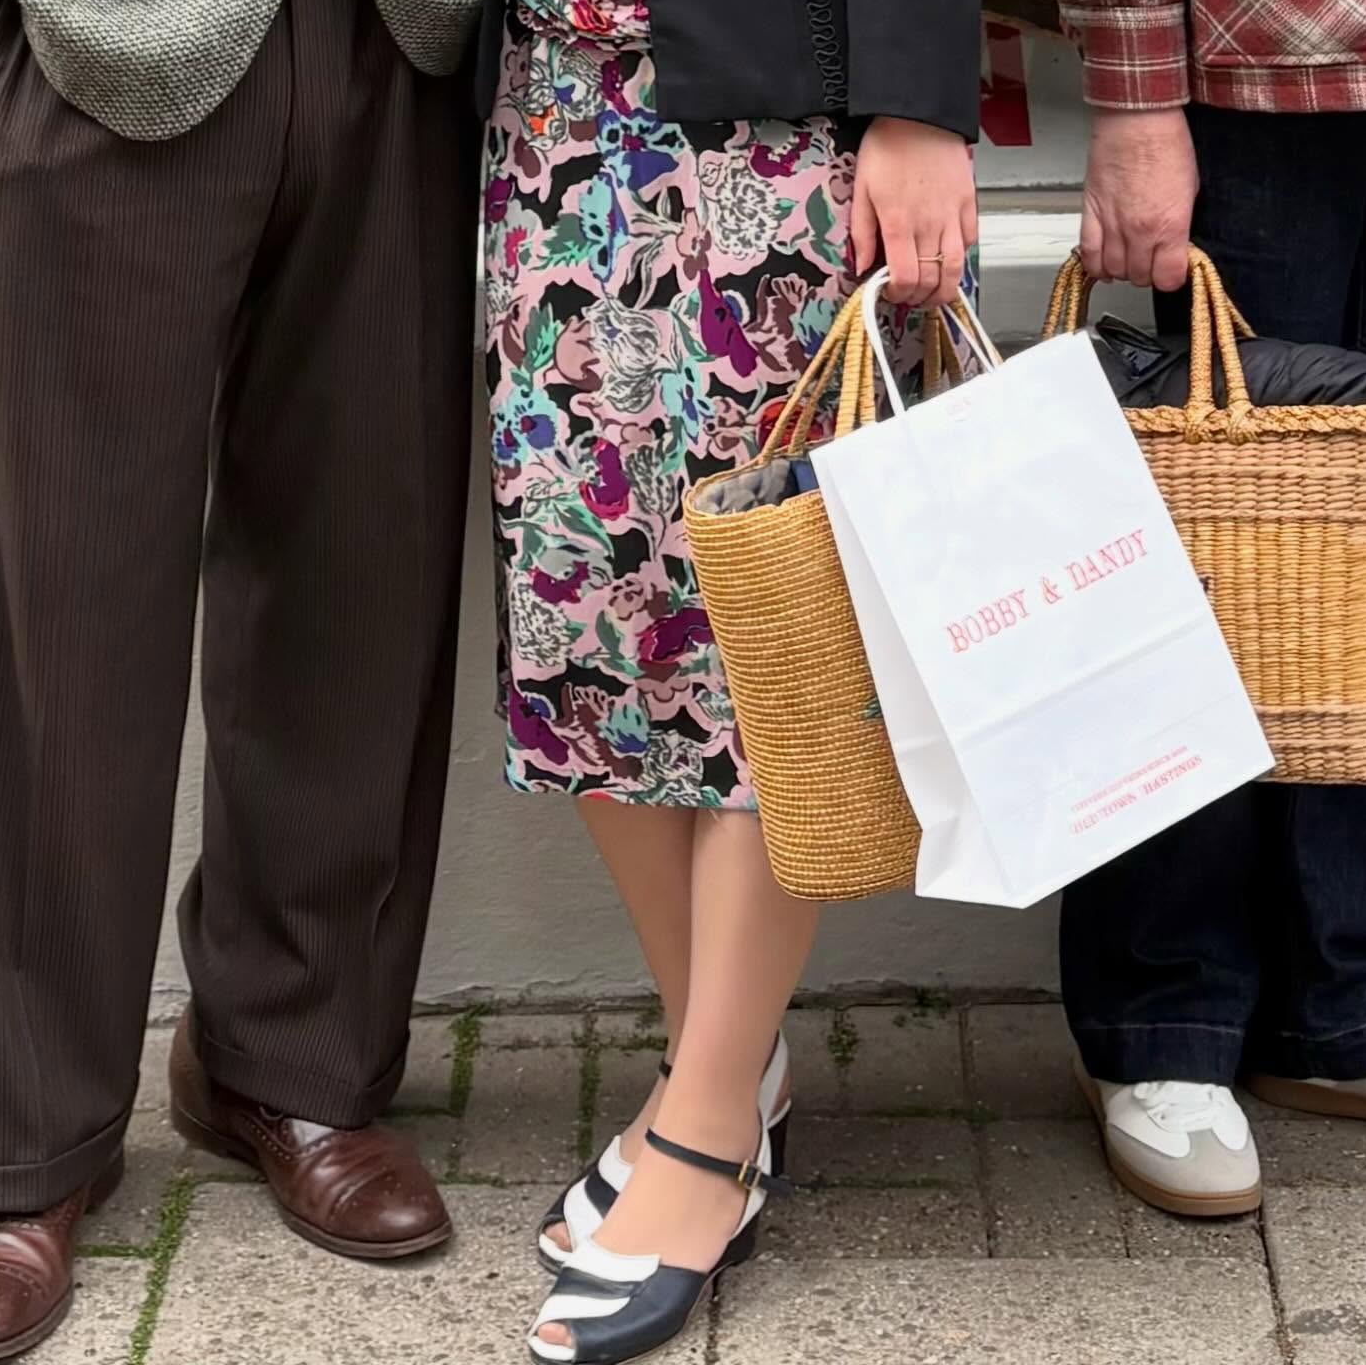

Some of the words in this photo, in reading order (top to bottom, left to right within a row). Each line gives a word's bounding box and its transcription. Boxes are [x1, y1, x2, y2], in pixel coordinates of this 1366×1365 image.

[944, 588, 1031, 653] BOBBY
[1039, 576, 1063, 605] &
[1063, 529, 1148, 591] DANDY
